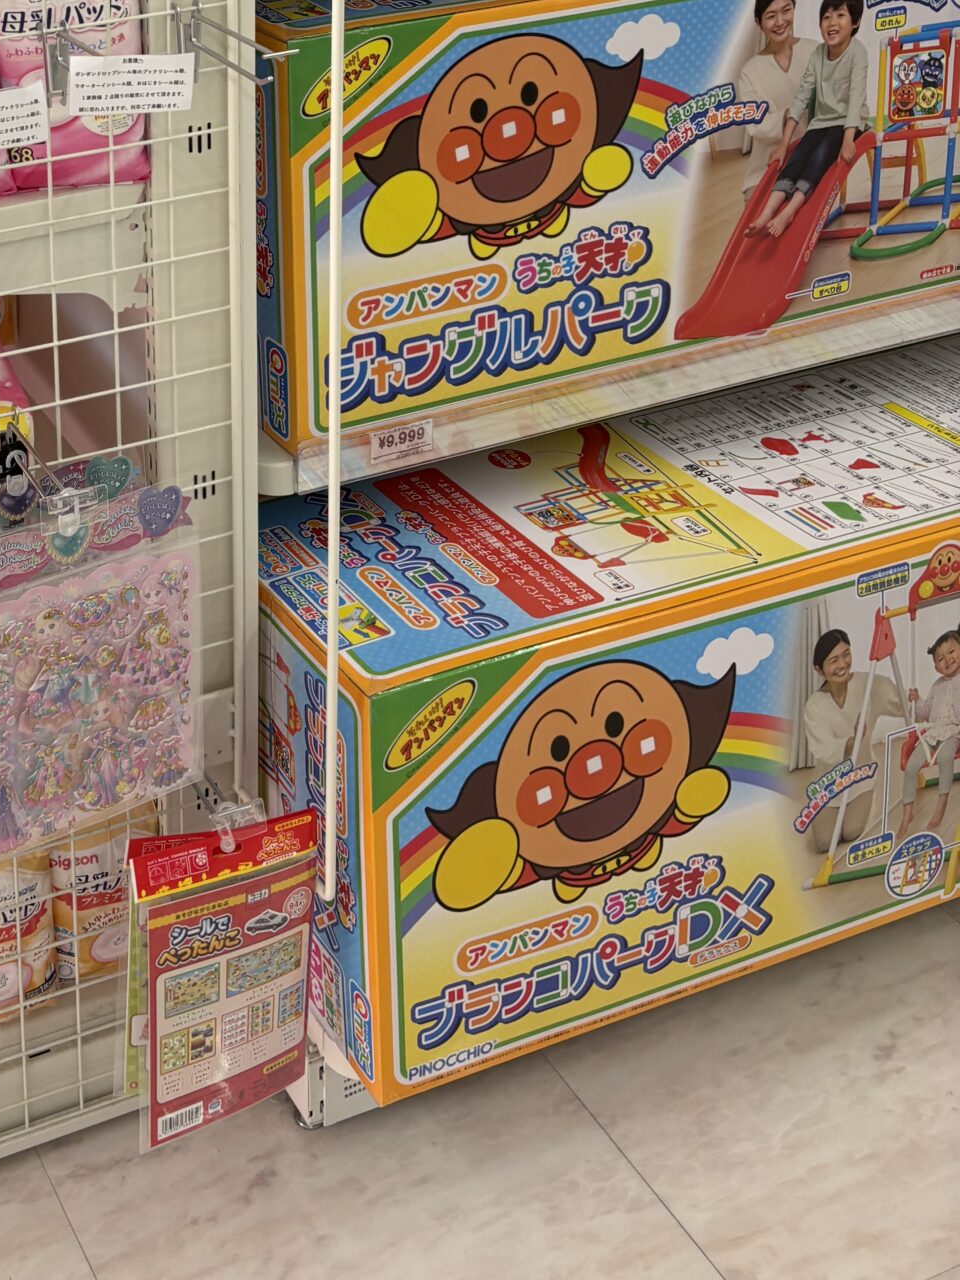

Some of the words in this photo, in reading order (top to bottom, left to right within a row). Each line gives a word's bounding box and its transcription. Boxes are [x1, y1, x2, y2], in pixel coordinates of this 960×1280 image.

[881, 19, 901, 27] のれん
[317, 53, 381, 110] アパンマン
[669, 86, 732, 126] 遊びながら
[644, 103, 768, 174] 運動能力を伸ばそう!
[359, 273, 498, 324] アンパンマン
[334, 284, 663, 404] ジャングルパーク
[378, 427, 424, 449] ¥9,999
[400, 697, 465, 761] アンパンマン
[248, 889, 269, 903] トミカ
[157, 929, 242, 967] ぺったんこ
[171, 915, 231, 945] シールで
[466, 912, 592, 967] アンパンマン
[412, 875, 774, 1047] ブランコパークDX
[408, 1042, 494, 1081] PINOCCHIO
